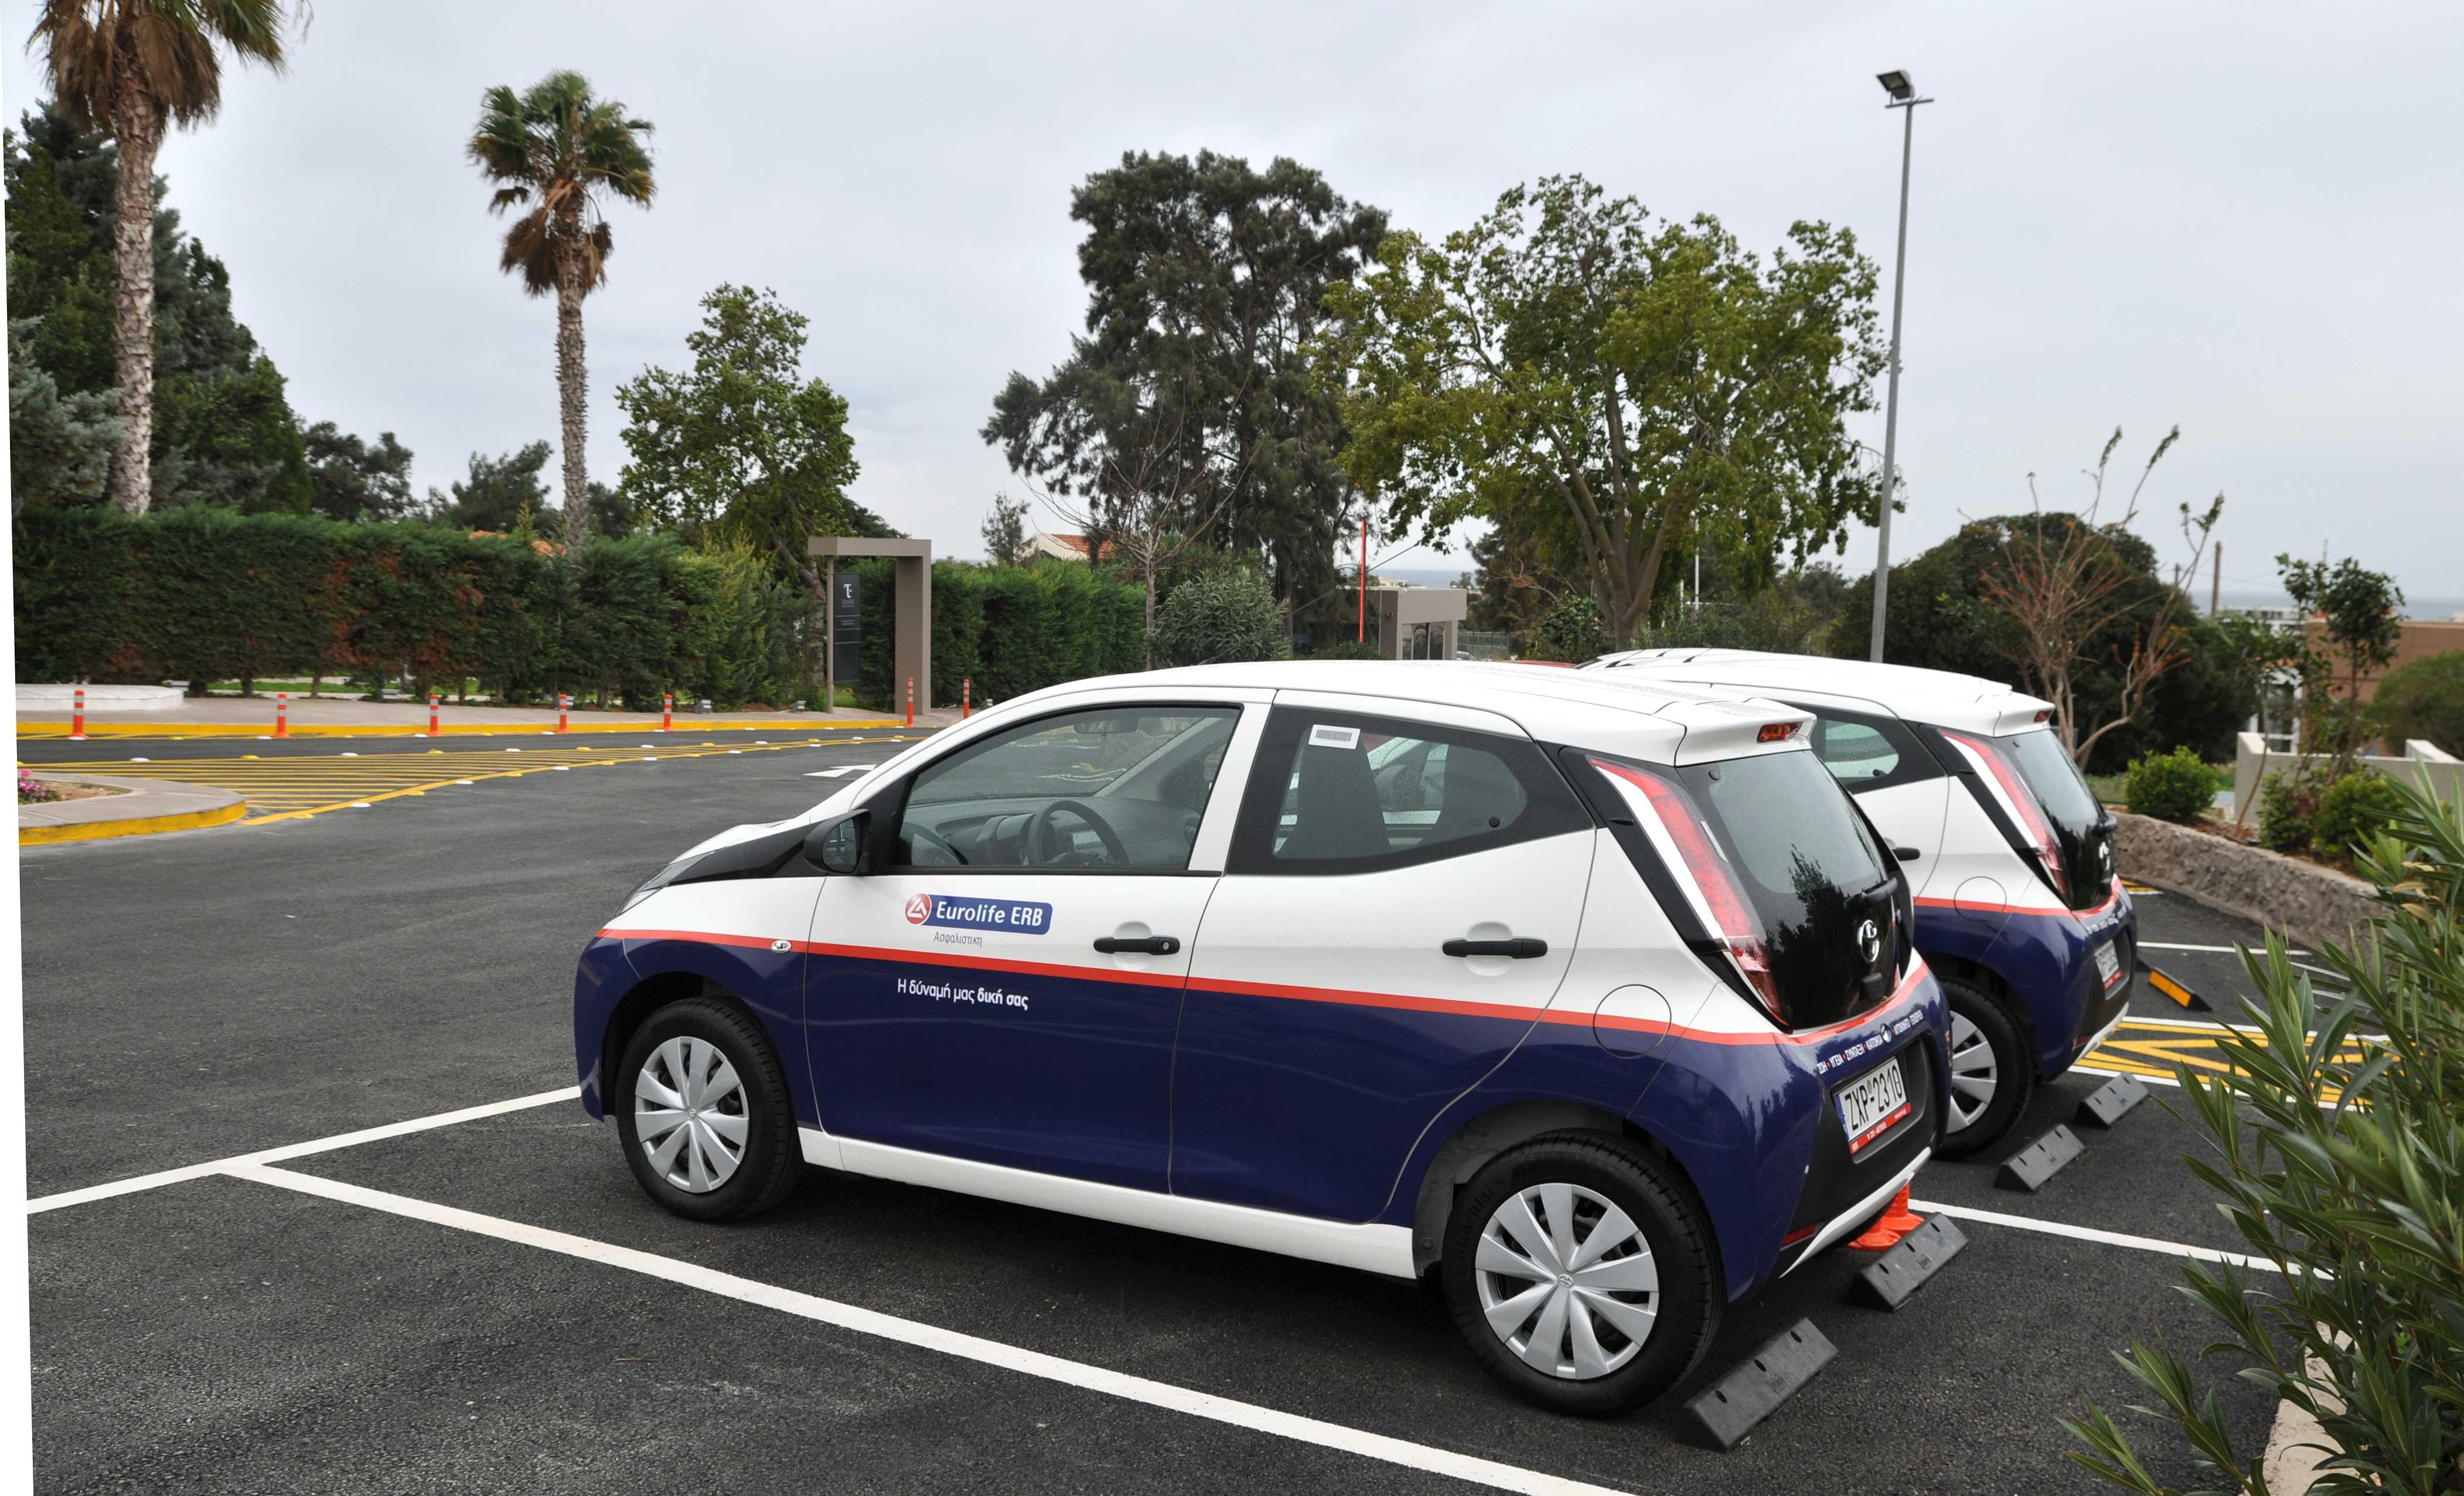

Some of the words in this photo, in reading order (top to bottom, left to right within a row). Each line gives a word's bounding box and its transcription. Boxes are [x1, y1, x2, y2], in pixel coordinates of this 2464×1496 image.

[936, 901, 1006, 924] Eurolife
[1010, 907, 1044, 926] ERB
[909, 980, 951, 1001] δύναμή
[953, 988, 975, 1004] μας
[977, 987, 1004, 1005] δική
[1006, 995, 1029, 1011] σας
